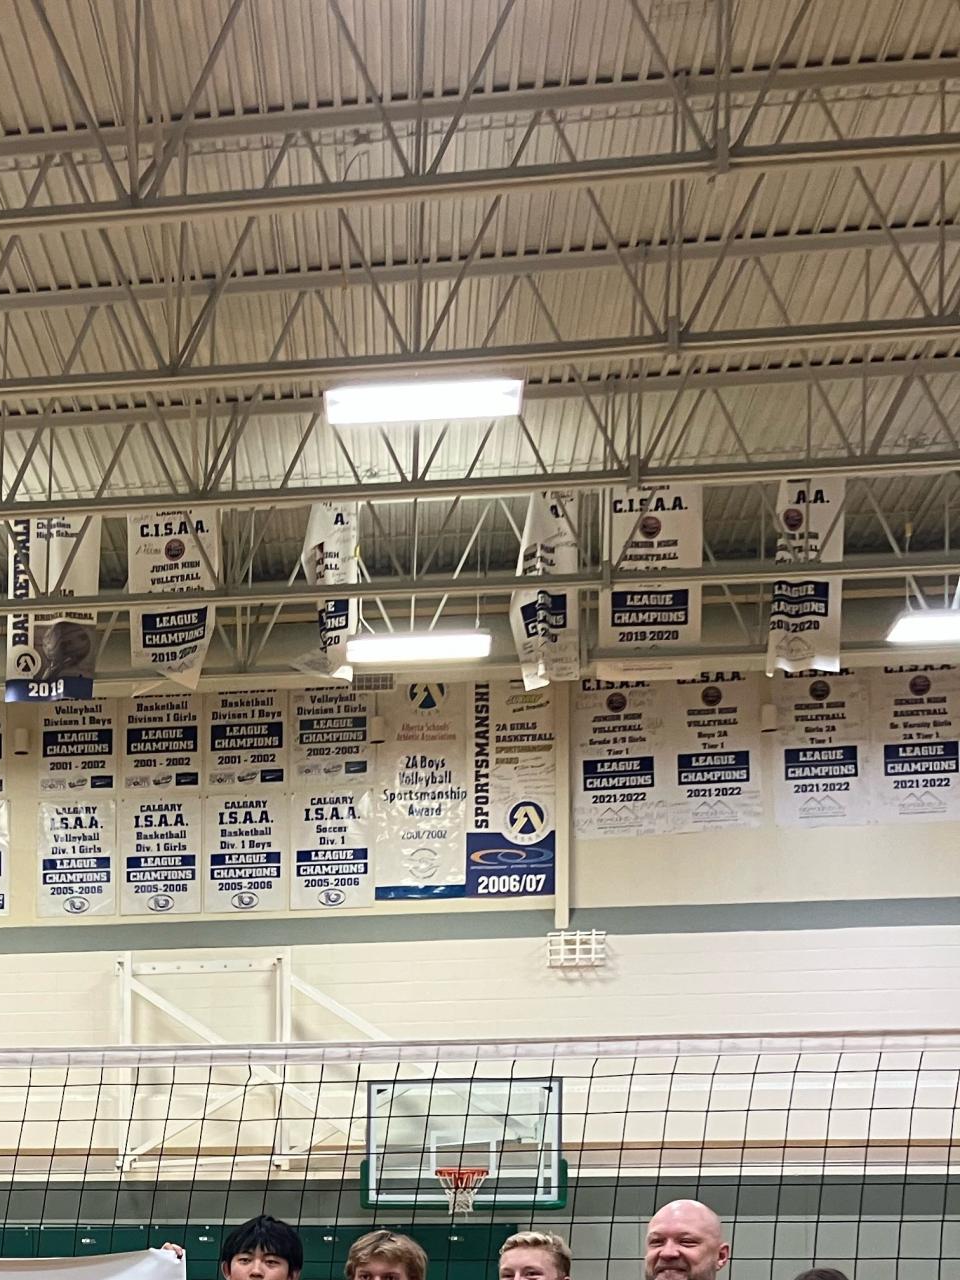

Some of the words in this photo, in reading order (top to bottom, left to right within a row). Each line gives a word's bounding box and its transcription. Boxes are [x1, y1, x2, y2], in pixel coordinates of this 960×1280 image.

[626, 594, 674, 606] LEAGUE
[155, 613, 199, 628] LEAGUE
[614, 611, 686, 624] CHAMPIONS
[145, 629, 205, 645] CHAMPIONS
[28, 679, 64, 697] 2019
[136, 702, 188, 712] Basketball
[221, 697, 273, 709] Basketball
[54, 704, 102, 715] Volleyball
[172, 712, 197, 722] Girls
[141, 729, 183, 740] LEAGUE
[225, 724, 269, 736] LEAGUE
[57, 731, 99, 742] LEAGUE
[214, 736, 279, 749] CHAMPIONS
[495, 732, 555, 743] BASKETBALL
[46, 743, 109, 755] CHAMPIONS
[130, 740, 194, 752] CHAMPIONS
[898, 745, 945, 757] LEAGUE
[475, 683, 490, 829] SPORTSMANSHI
[691, 755, 735, 766] LEAGUE
[799, 749, 844, 762] LEAGUE
[420, 756, 445, 769] Boys
[597, 760, 641, 773] LEAGUE
[886, 760, 957, 774] CHAMPIONS
[681, 770, 747, 783] CHAMPIONS
[787, 764, 856, 778] CHAMPIONS
[399, 771, 452, 787] Volleyball
[586, 775, 652, 789] CHAMPIONS
[310, 796, 354, 806] CALGARY
[383, 789, 467, 805] Sportsmanship
[140, 803, 183, 813] CALGARY
[224, 800, 268, 809] CALGARY
[408, 804, 442, 816] Award
[218, 810, 274, 825] I.S.A.A.
[304, 806, 361, 821] I.S.A.A.
[134, 812, 189, 829] I.S.A.A.
[136, 830, 187, 840] Basketball
[220, 827, 272, 838] Basketball
[78, 844, 102, 854] Girls
[162, 842, 187, 852] Girls
[248, 839, 272, 850] Boys
[225, 853, 267, 865] LEAGUE
[310, 849, 354, 861] LEAGUE
[56, 858, 97, 869] LEAGUE
[140, 856, 182, 867] LEAGUE
[213, 867, 278, 879] CHAMPIONS
[299, 863, 365, 876] CHAMPIONS
[45, 871, 107, 883] CHAMPIONS
[129, 870, 192, 882] CHAMPIONS
[477, 874, 547, 895] 2006/07
